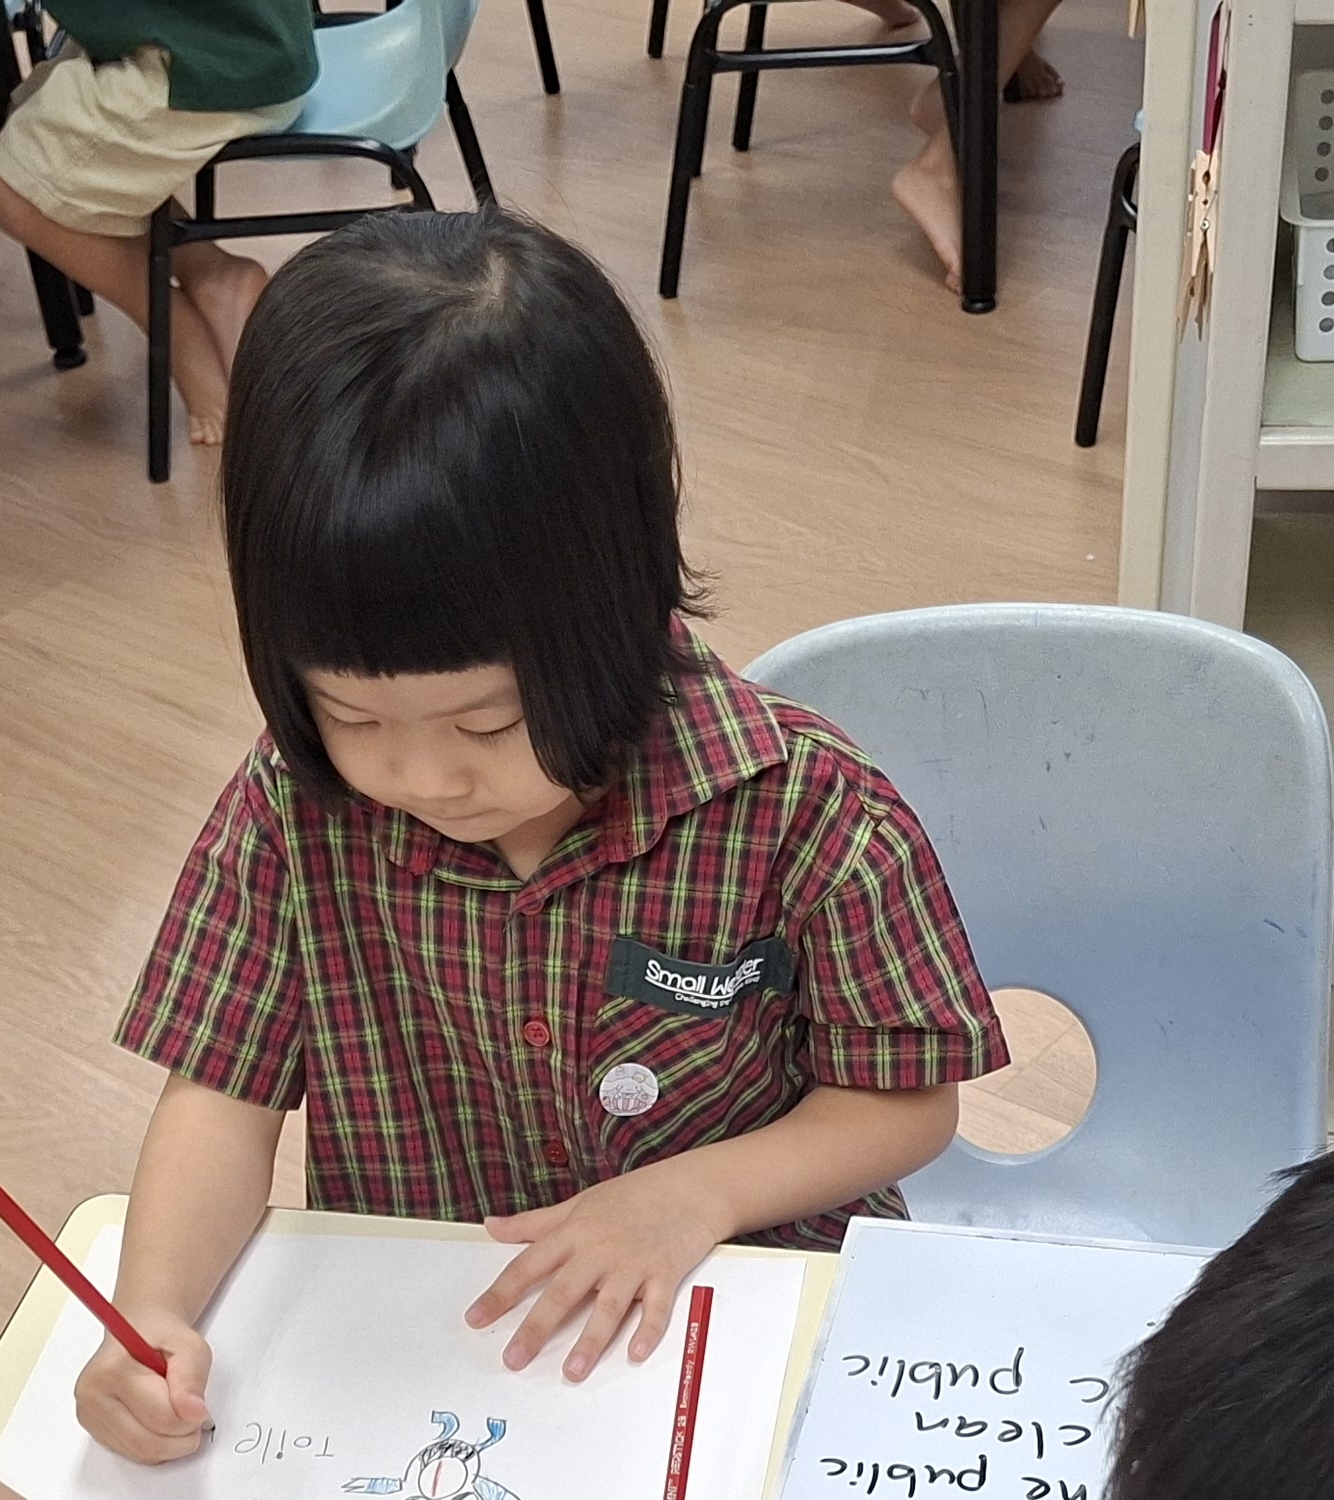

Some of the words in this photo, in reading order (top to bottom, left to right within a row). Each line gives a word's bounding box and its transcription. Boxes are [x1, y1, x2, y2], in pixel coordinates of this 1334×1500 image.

[646, 959, 707, 993] Small
[841, 1346, 1025, 1401] public
[234, 1422, 335, 1466] Toile
[914, 1411, 1092, 1460] clean
[819, 1453, 988, 1499] public
